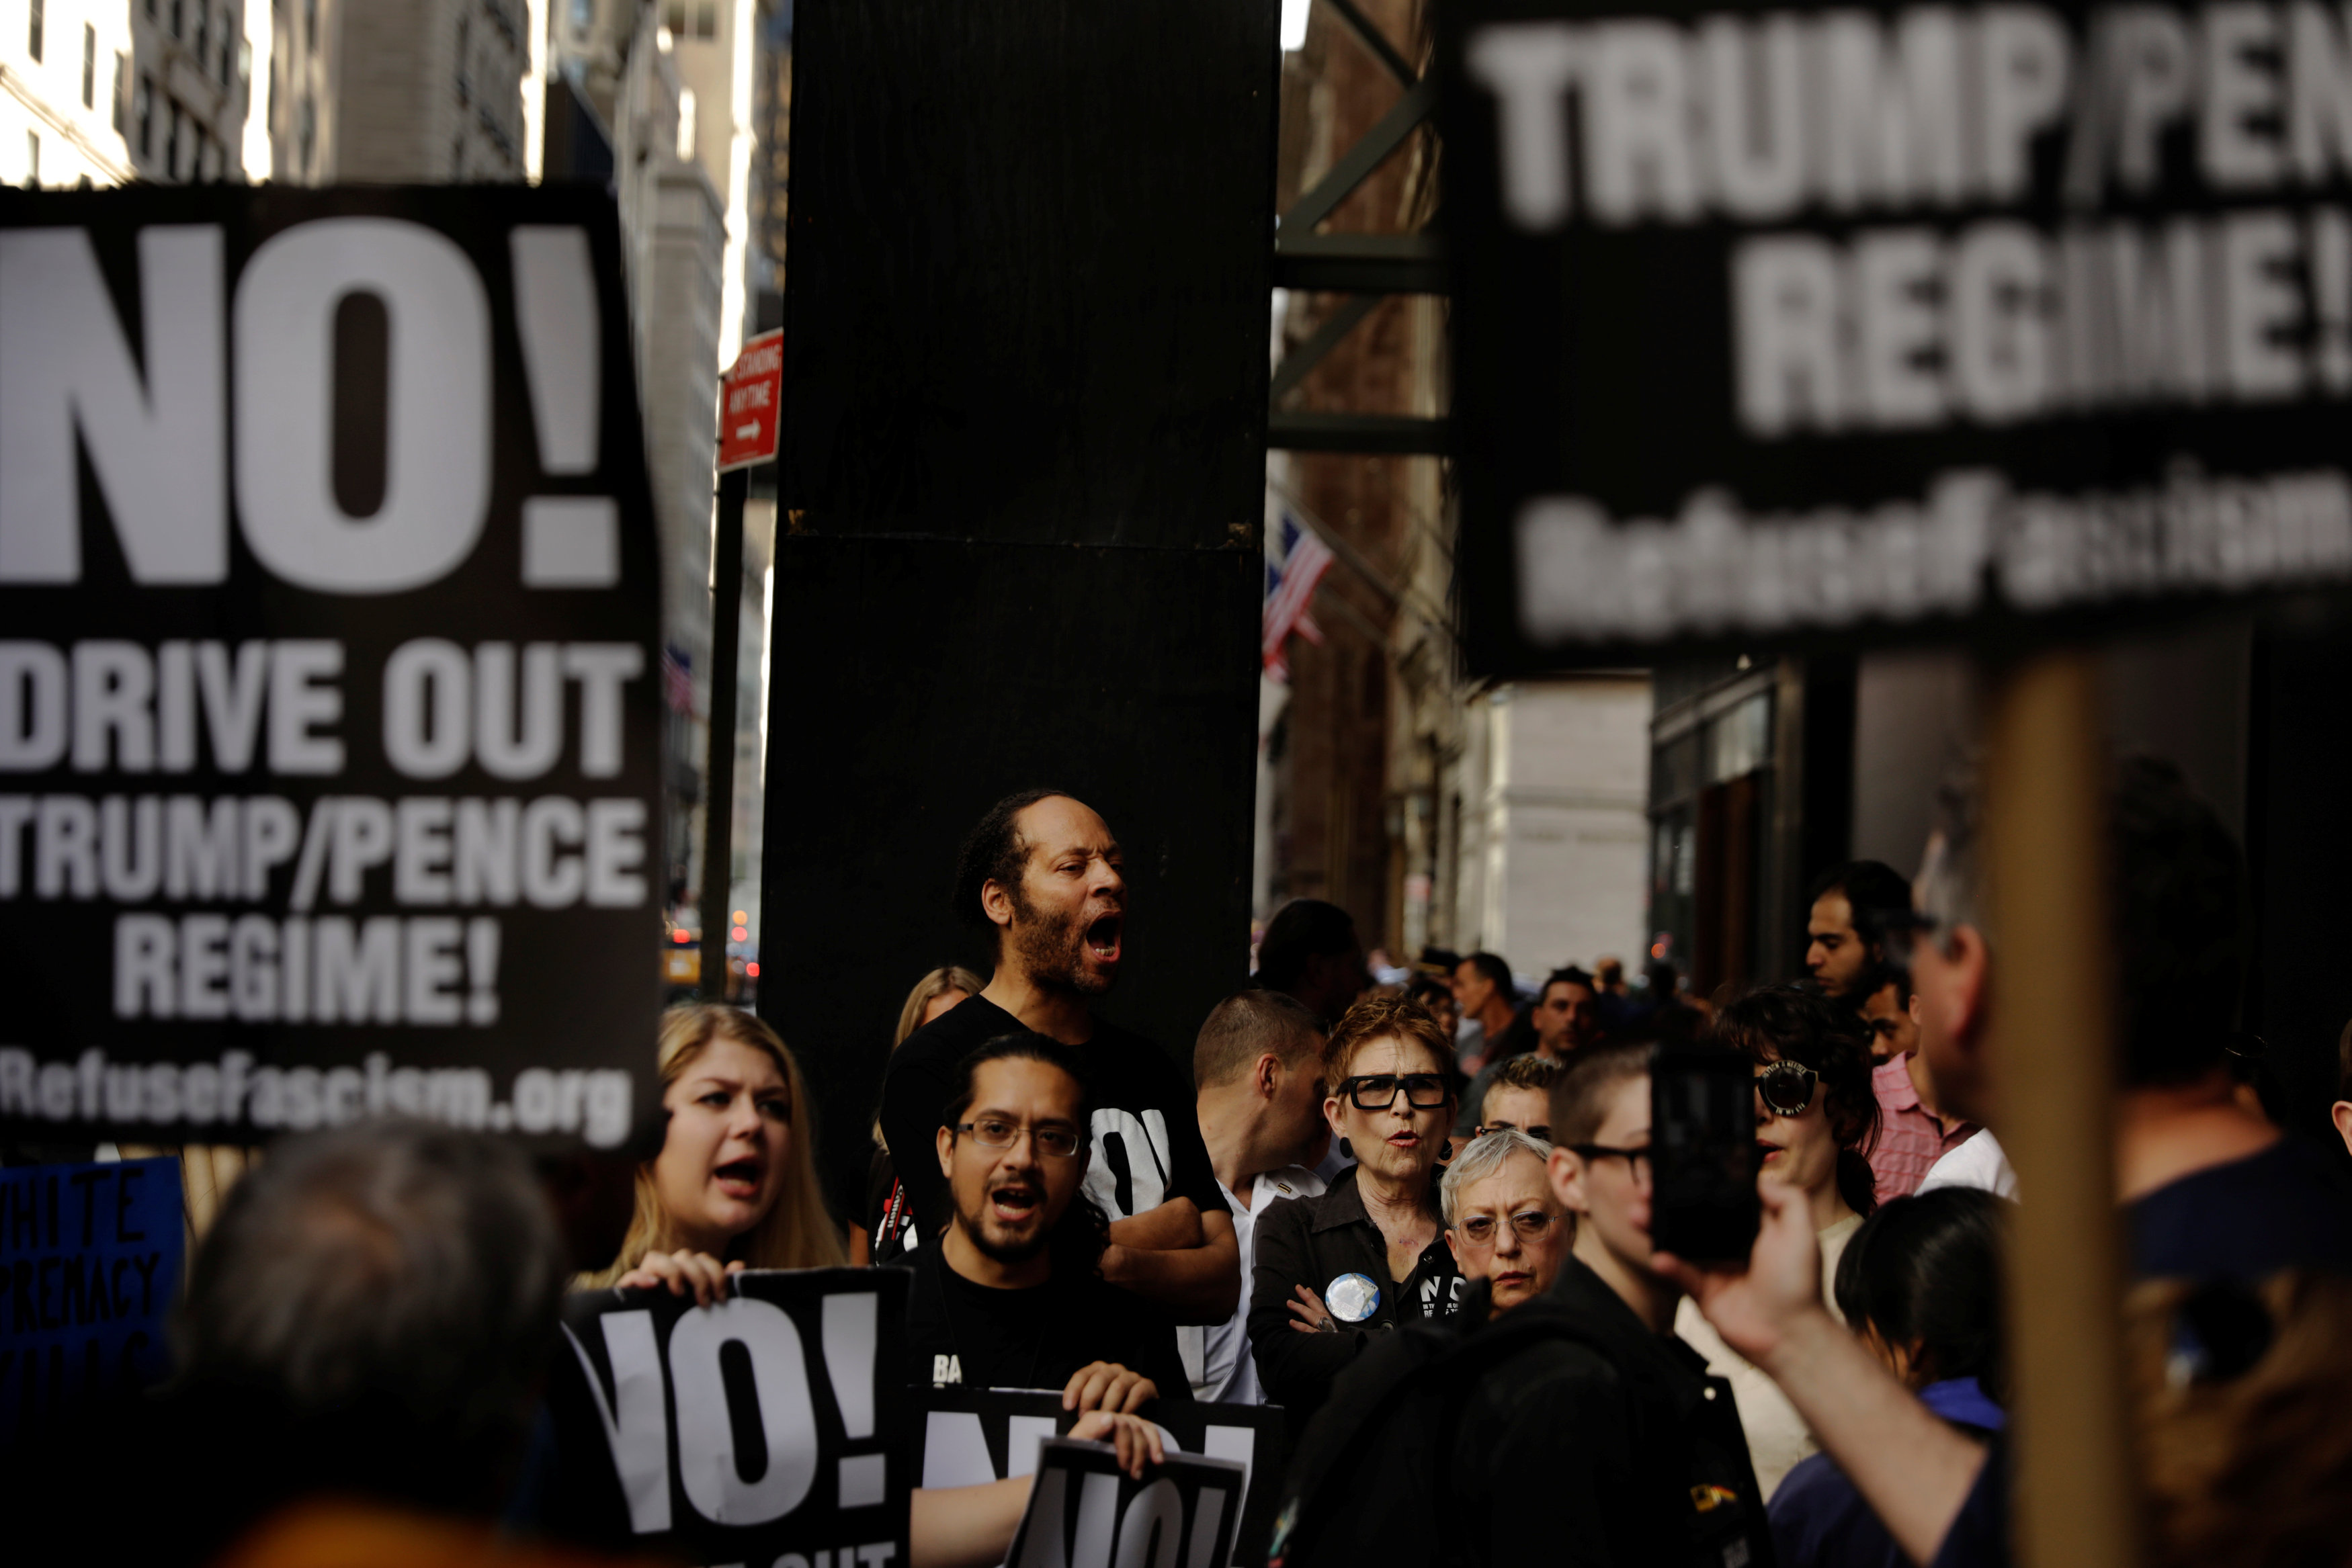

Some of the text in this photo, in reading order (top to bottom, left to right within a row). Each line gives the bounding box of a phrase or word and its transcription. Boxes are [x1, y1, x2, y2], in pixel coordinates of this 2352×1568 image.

[0, 215, 621, 597] NO!
[728, 379, 772, 415] ANYTIME
[0, 637, 643, 779] DRIVE OUT
[0, 793, 646, 910] TRUMP/PENCE
[114, 914, 500, 1025] REGIME!
[887, 1184, 904, 1228] Canon
[933, 1354, 962, 1384] BA
